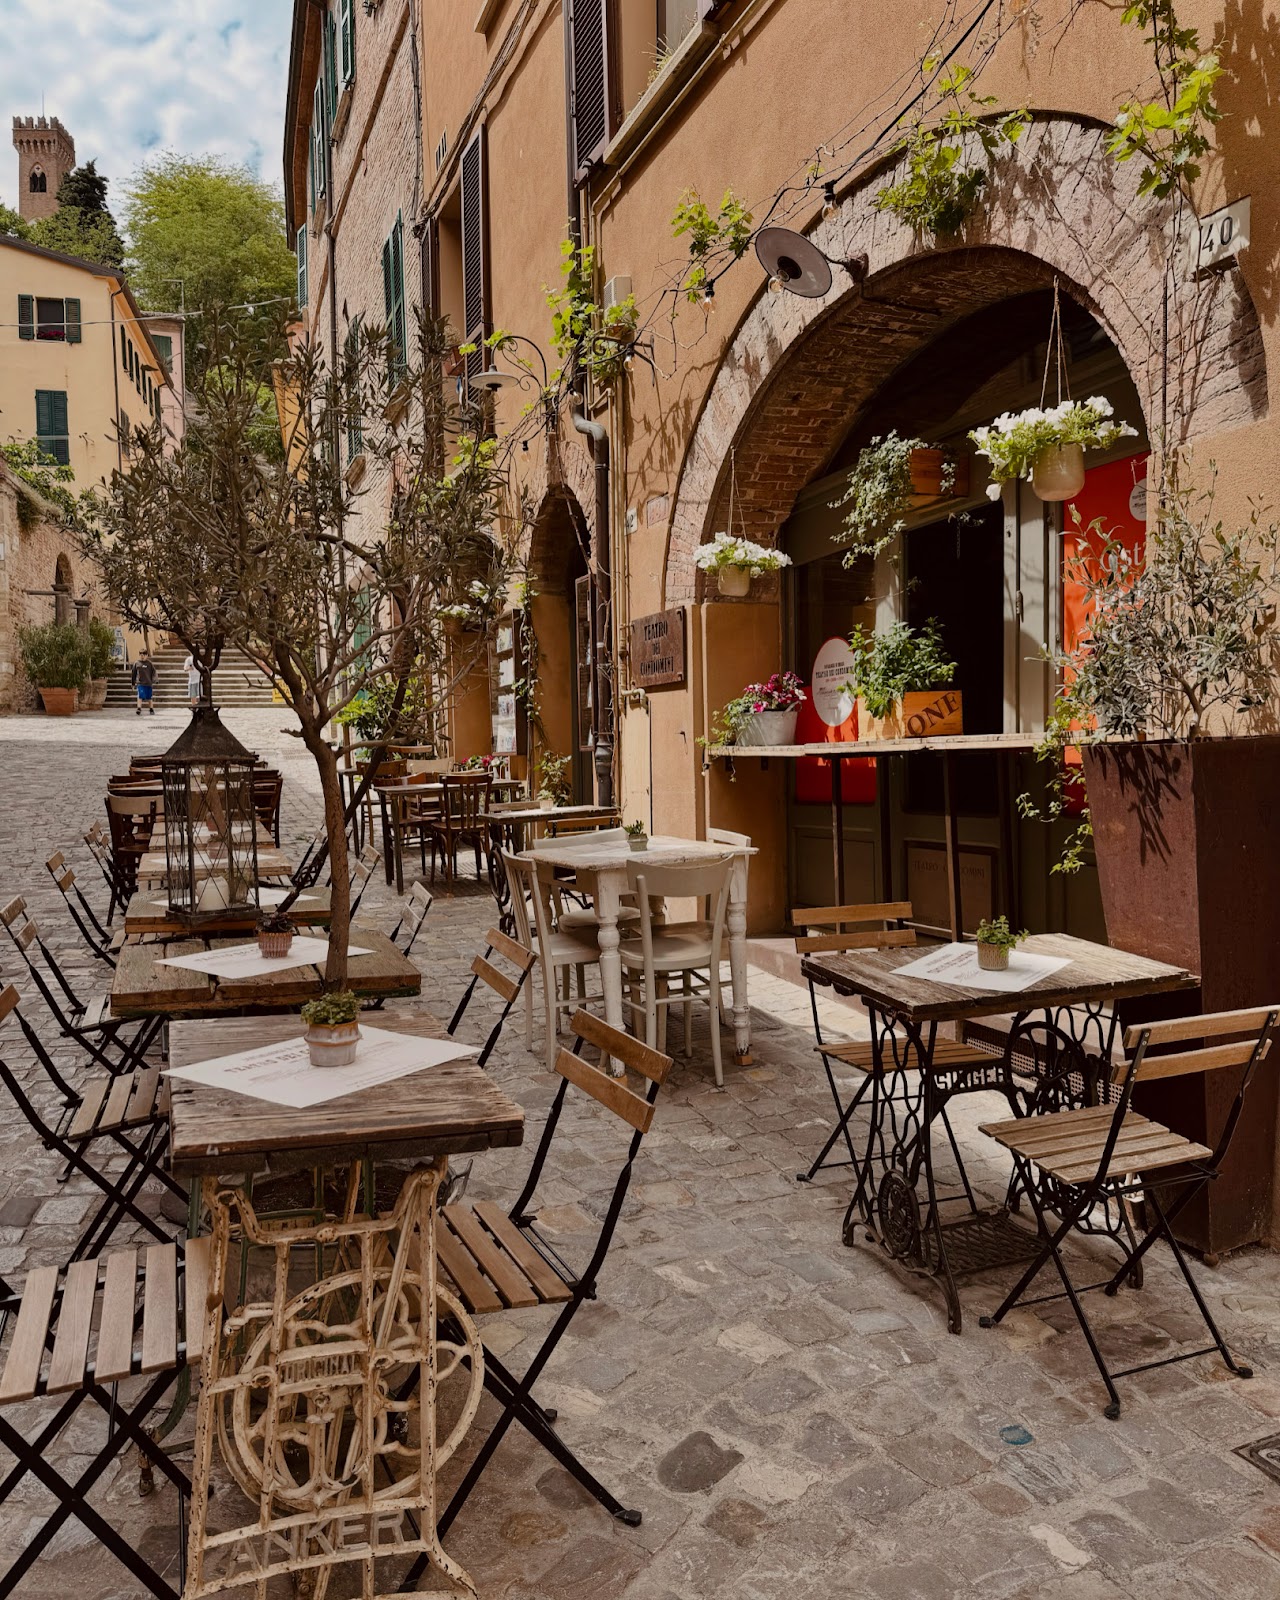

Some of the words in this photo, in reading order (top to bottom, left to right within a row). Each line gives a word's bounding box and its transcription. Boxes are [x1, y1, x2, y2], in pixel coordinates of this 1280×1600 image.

[1201, 216, 1233, 253] 40
[644, 621, 668, 642] TEATRO
[907, 692, 960, 736] ONE
[284, 1355, 360, 1383] ORIGINAL
[226, 1511, 405, 1579] ANKER
